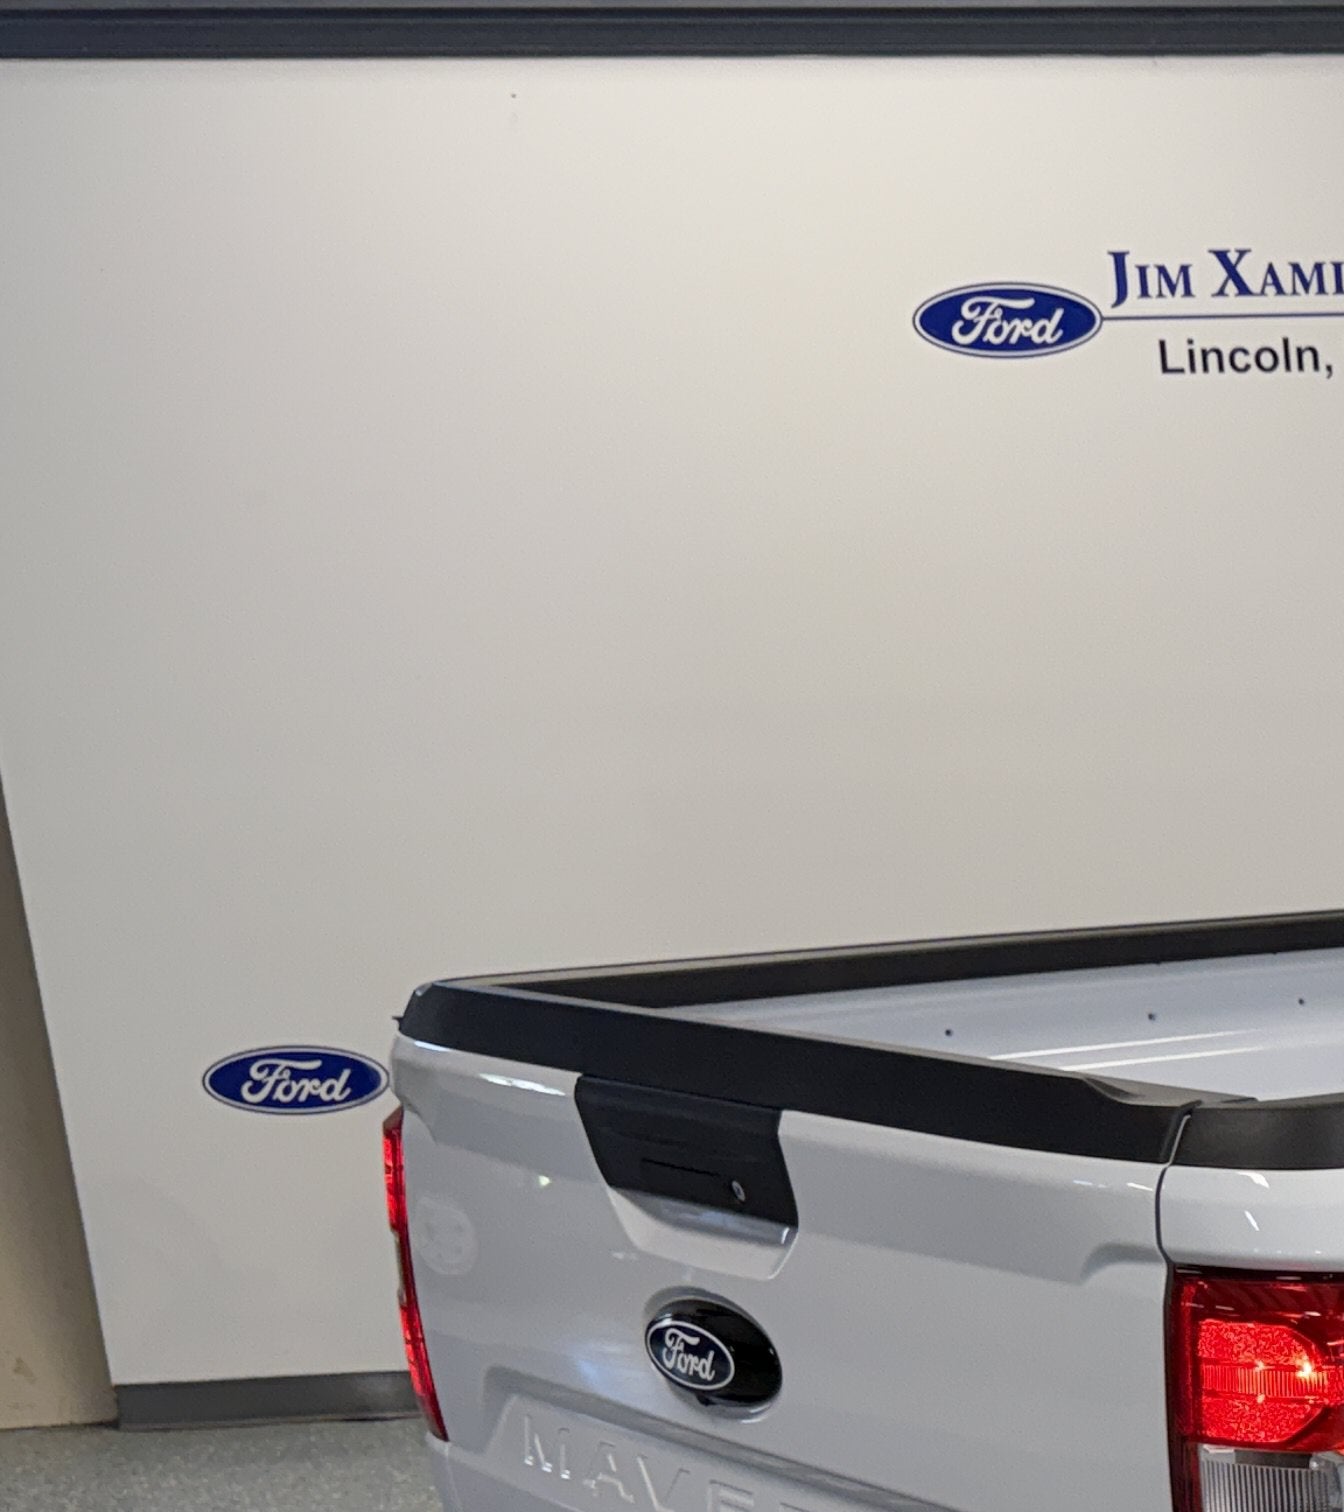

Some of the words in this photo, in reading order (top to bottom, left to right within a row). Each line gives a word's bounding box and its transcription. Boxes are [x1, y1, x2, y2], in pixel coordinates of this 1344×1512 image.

[1107, 250, 1196, 309] JIM
[950, 294, 1064, 347] Ford
[1158, 337, 1335, 379] Lincoln,
[241, 1058, 352, 1104] Ford
[662, 1327, 717, 1382] Ford
